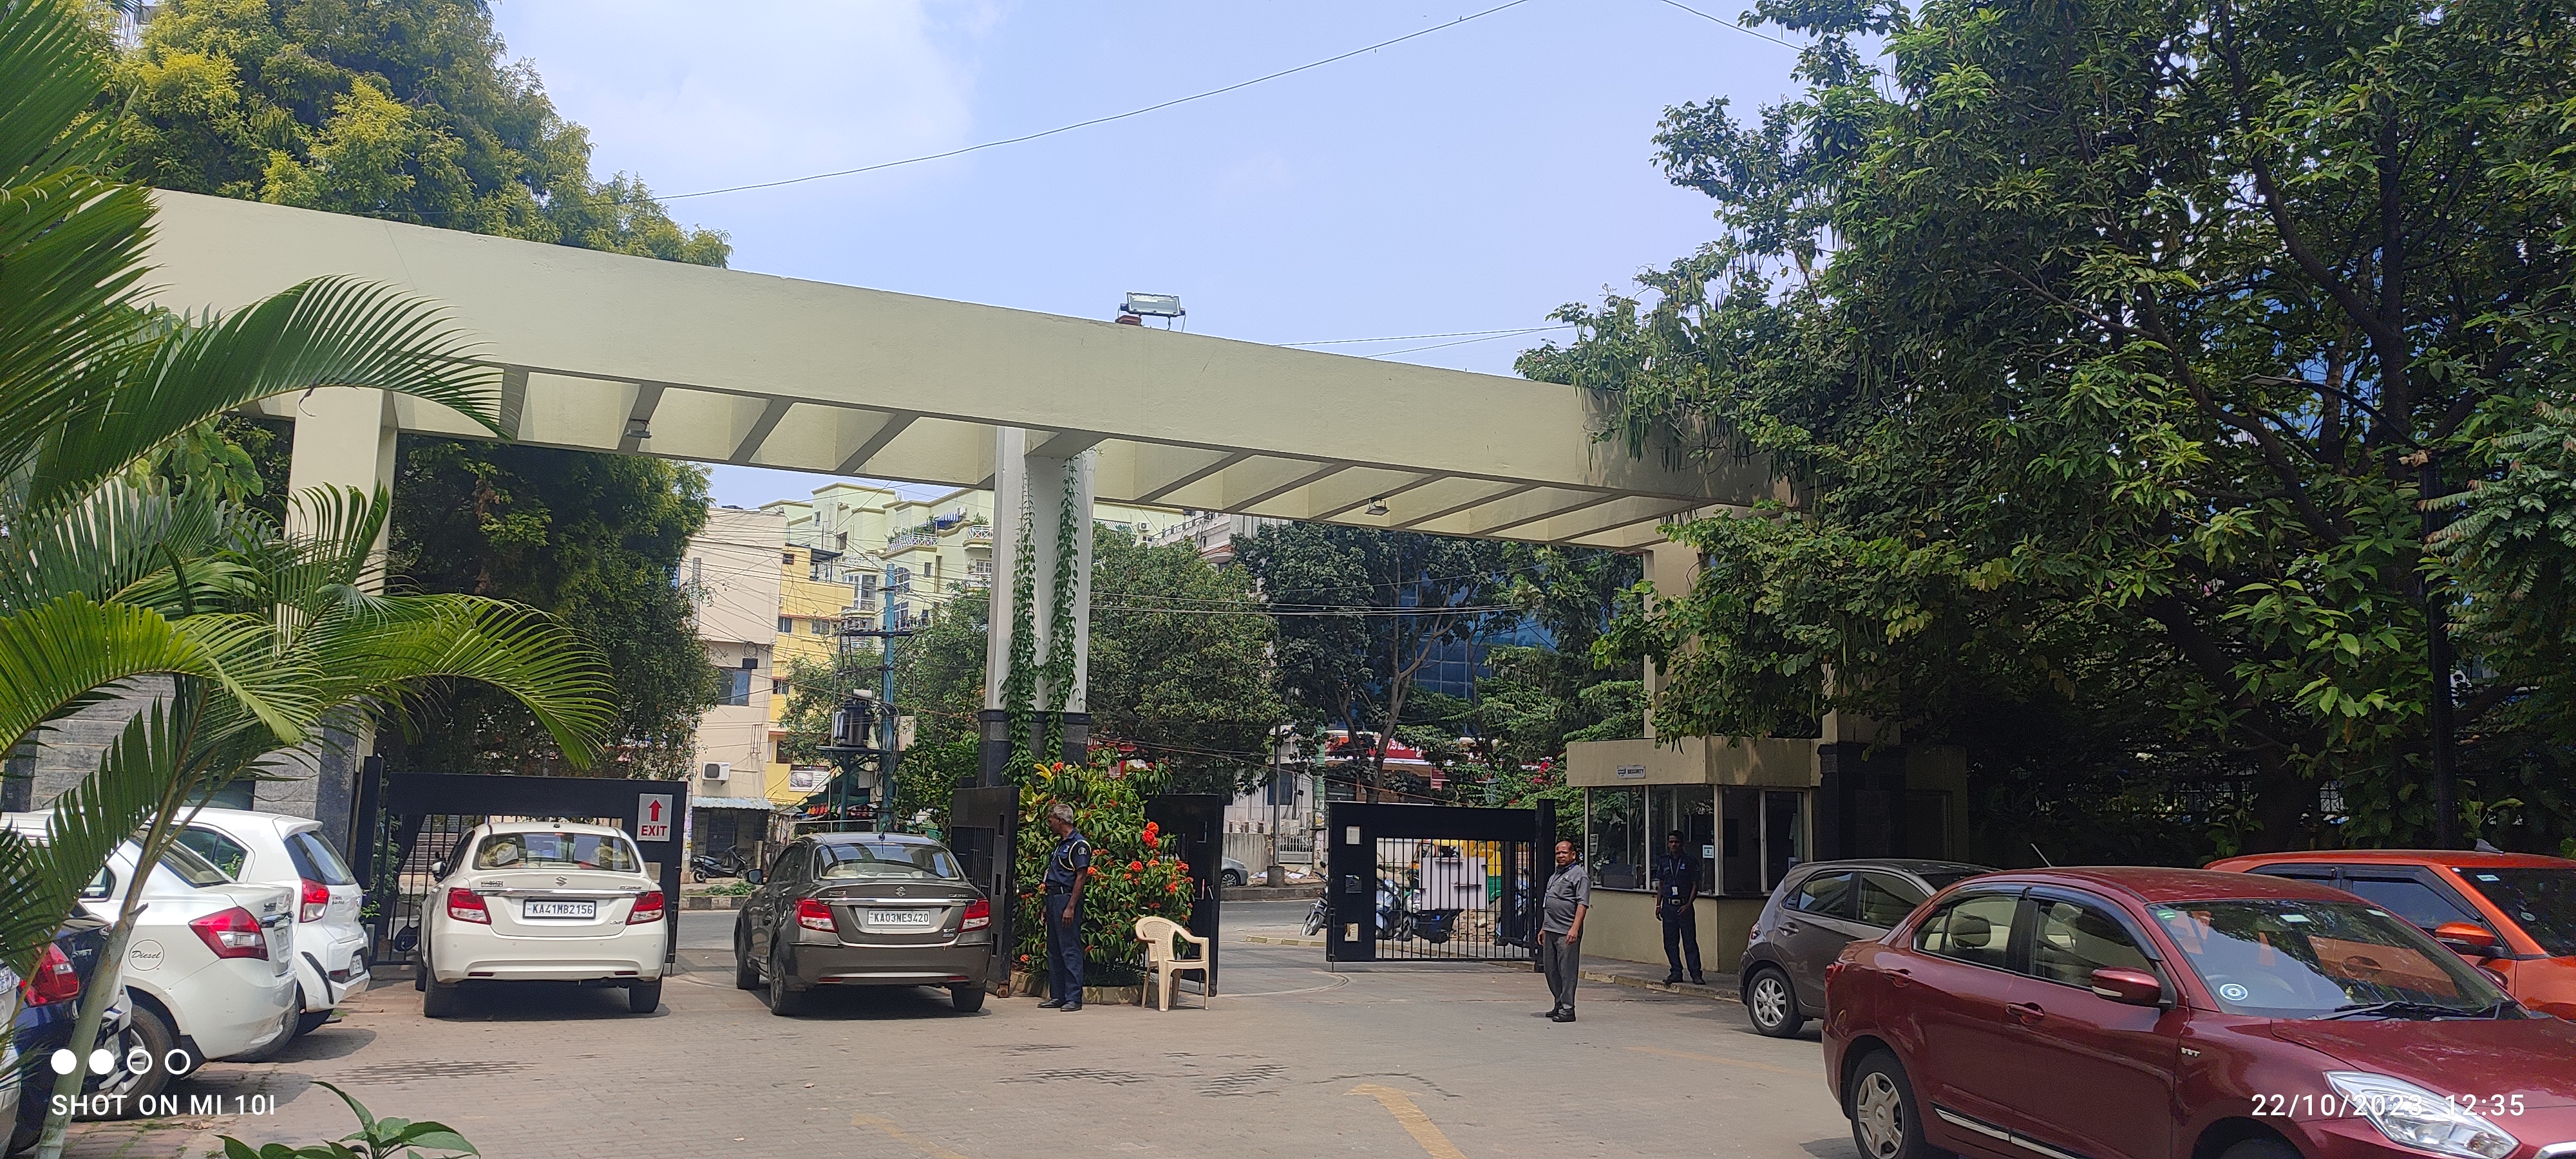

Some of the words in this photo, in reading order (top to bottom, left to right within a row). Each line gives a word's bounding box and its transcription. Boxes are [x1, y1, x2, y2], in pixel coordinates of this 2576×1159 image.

[641, 825, 668, 836] EXIT
[874, 913, 929, 923] KA03NE9420
[131, 950, 162, 959] Diesel
